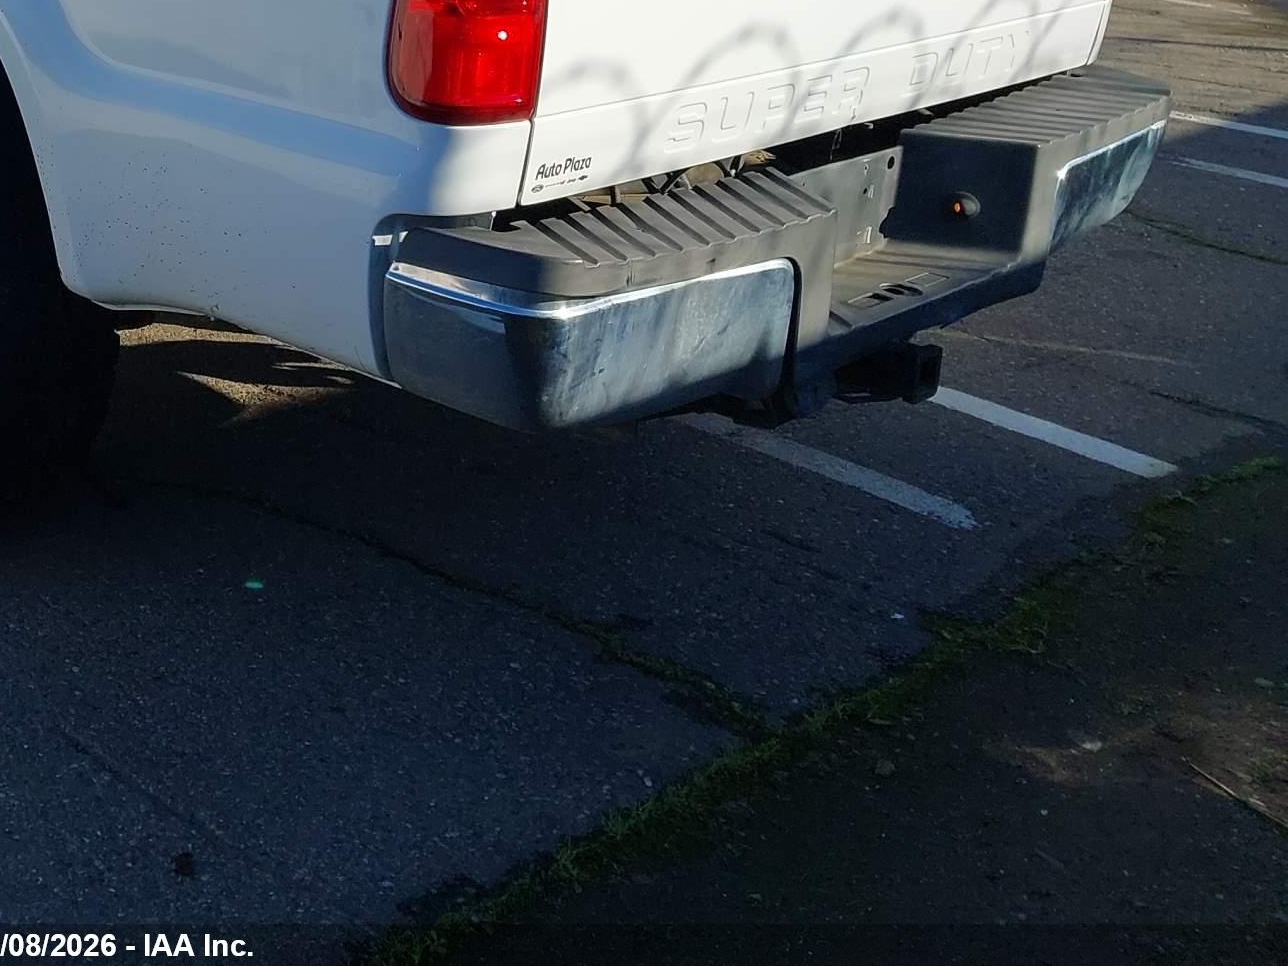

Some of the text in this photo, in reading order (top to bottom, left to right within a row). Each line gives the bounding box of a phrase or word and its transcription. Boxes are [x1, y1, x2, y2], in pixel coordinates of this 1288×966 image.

[663, 30, 1033, 153] SUPER DUTY
[534, 156, 592, 180] Auto Plaza
